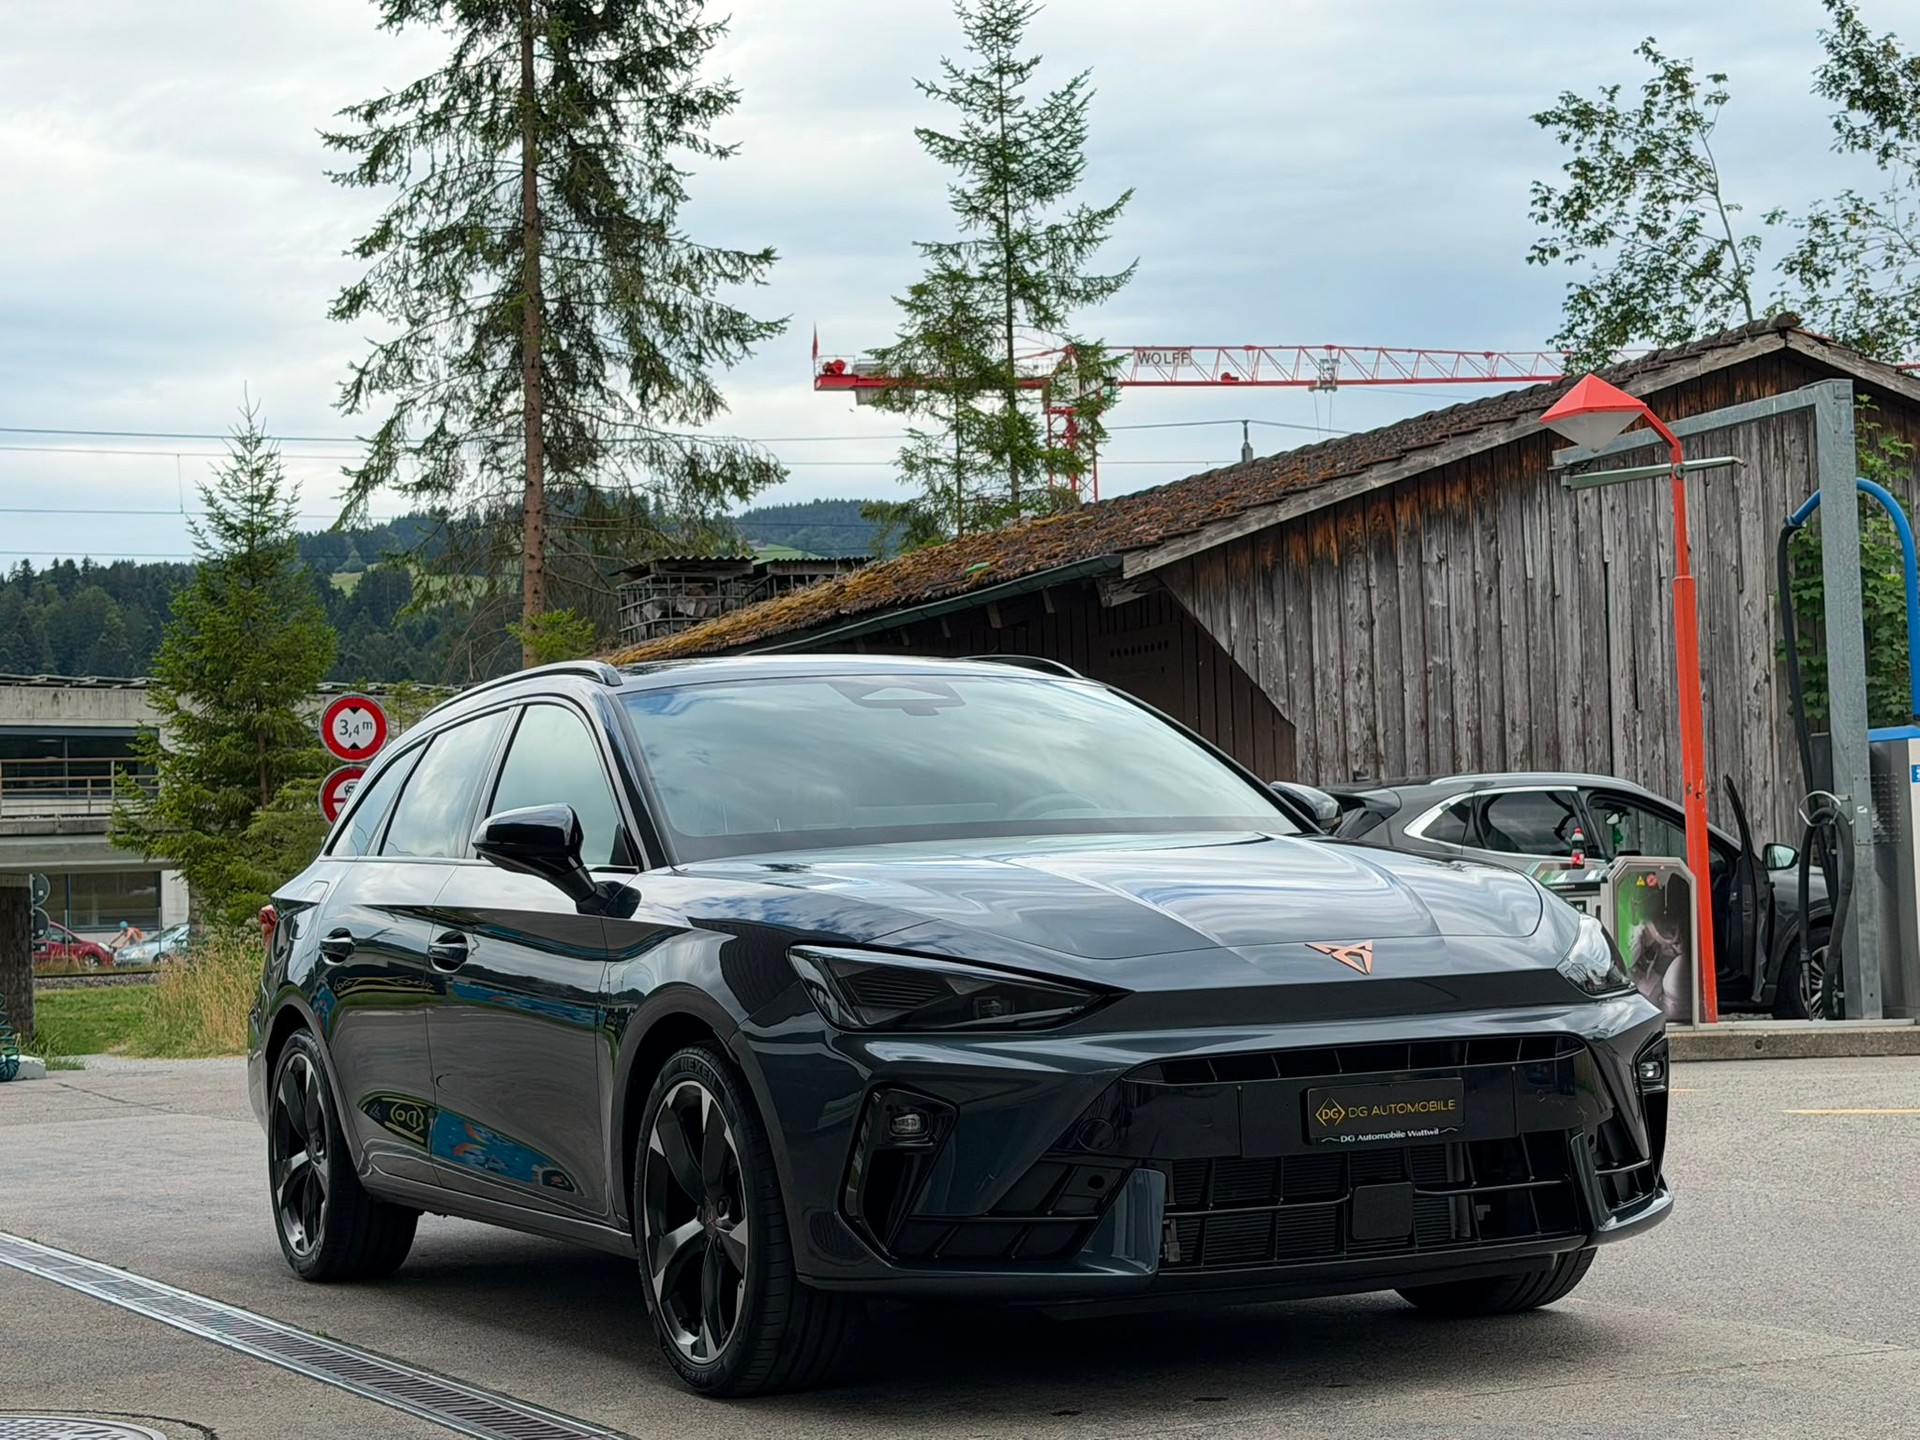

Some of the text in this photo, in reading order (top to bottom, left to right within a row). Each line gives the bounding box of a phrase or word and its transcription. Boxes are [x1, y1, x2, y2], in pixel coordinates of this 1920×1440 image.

[1137, 352, 1189, 365] WOLFF
[680, 1058, 717, 1088] NEXEN
[1322, 1099, 1456, 1120] DG DG AUTOMOBILE
[1340, 1127, 1439, 1143] DG Automobile Wattwil
